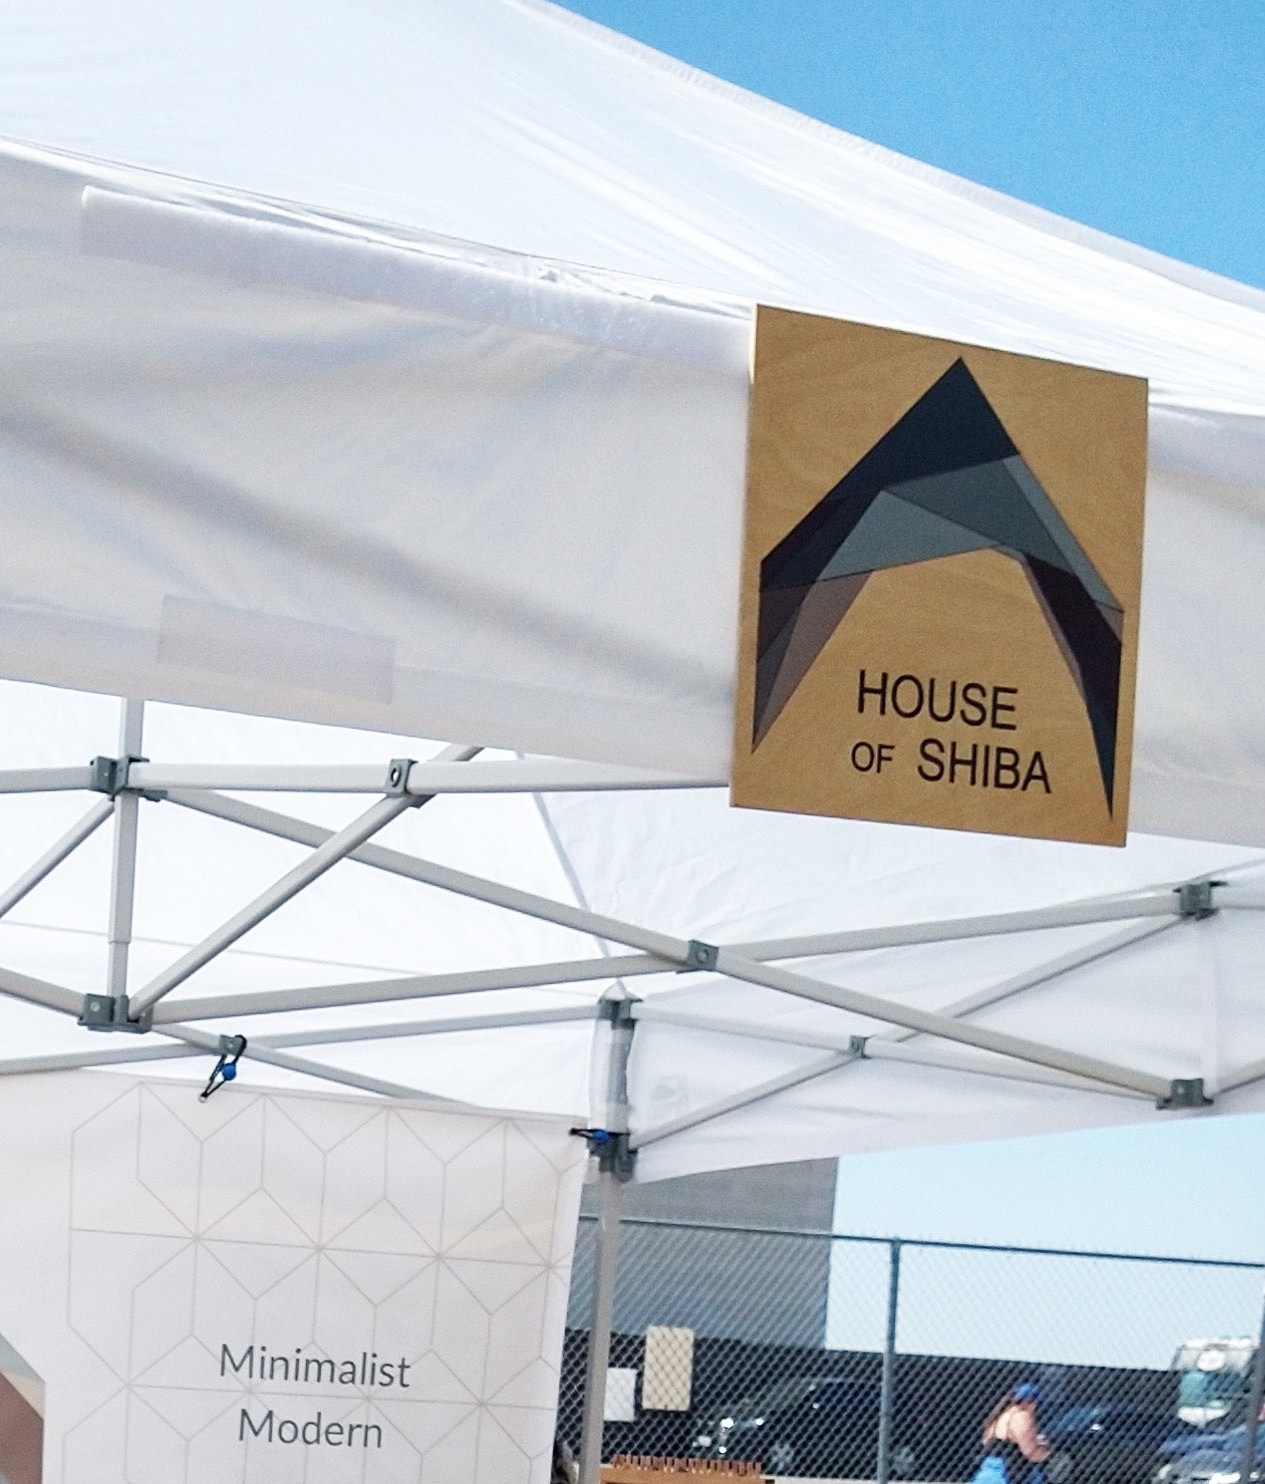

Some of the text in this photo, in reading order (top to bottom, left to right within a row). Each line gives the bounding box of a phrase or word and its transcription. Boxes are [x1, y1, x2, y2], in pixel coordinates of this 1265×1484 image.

[857, 669, 1018, 731] HOUSE
[851, 738, 1052, 794] OF SHIBA
[220, 1343, 411, 1388] Minimalist
[239, 1408, 382, 1449] Modern
